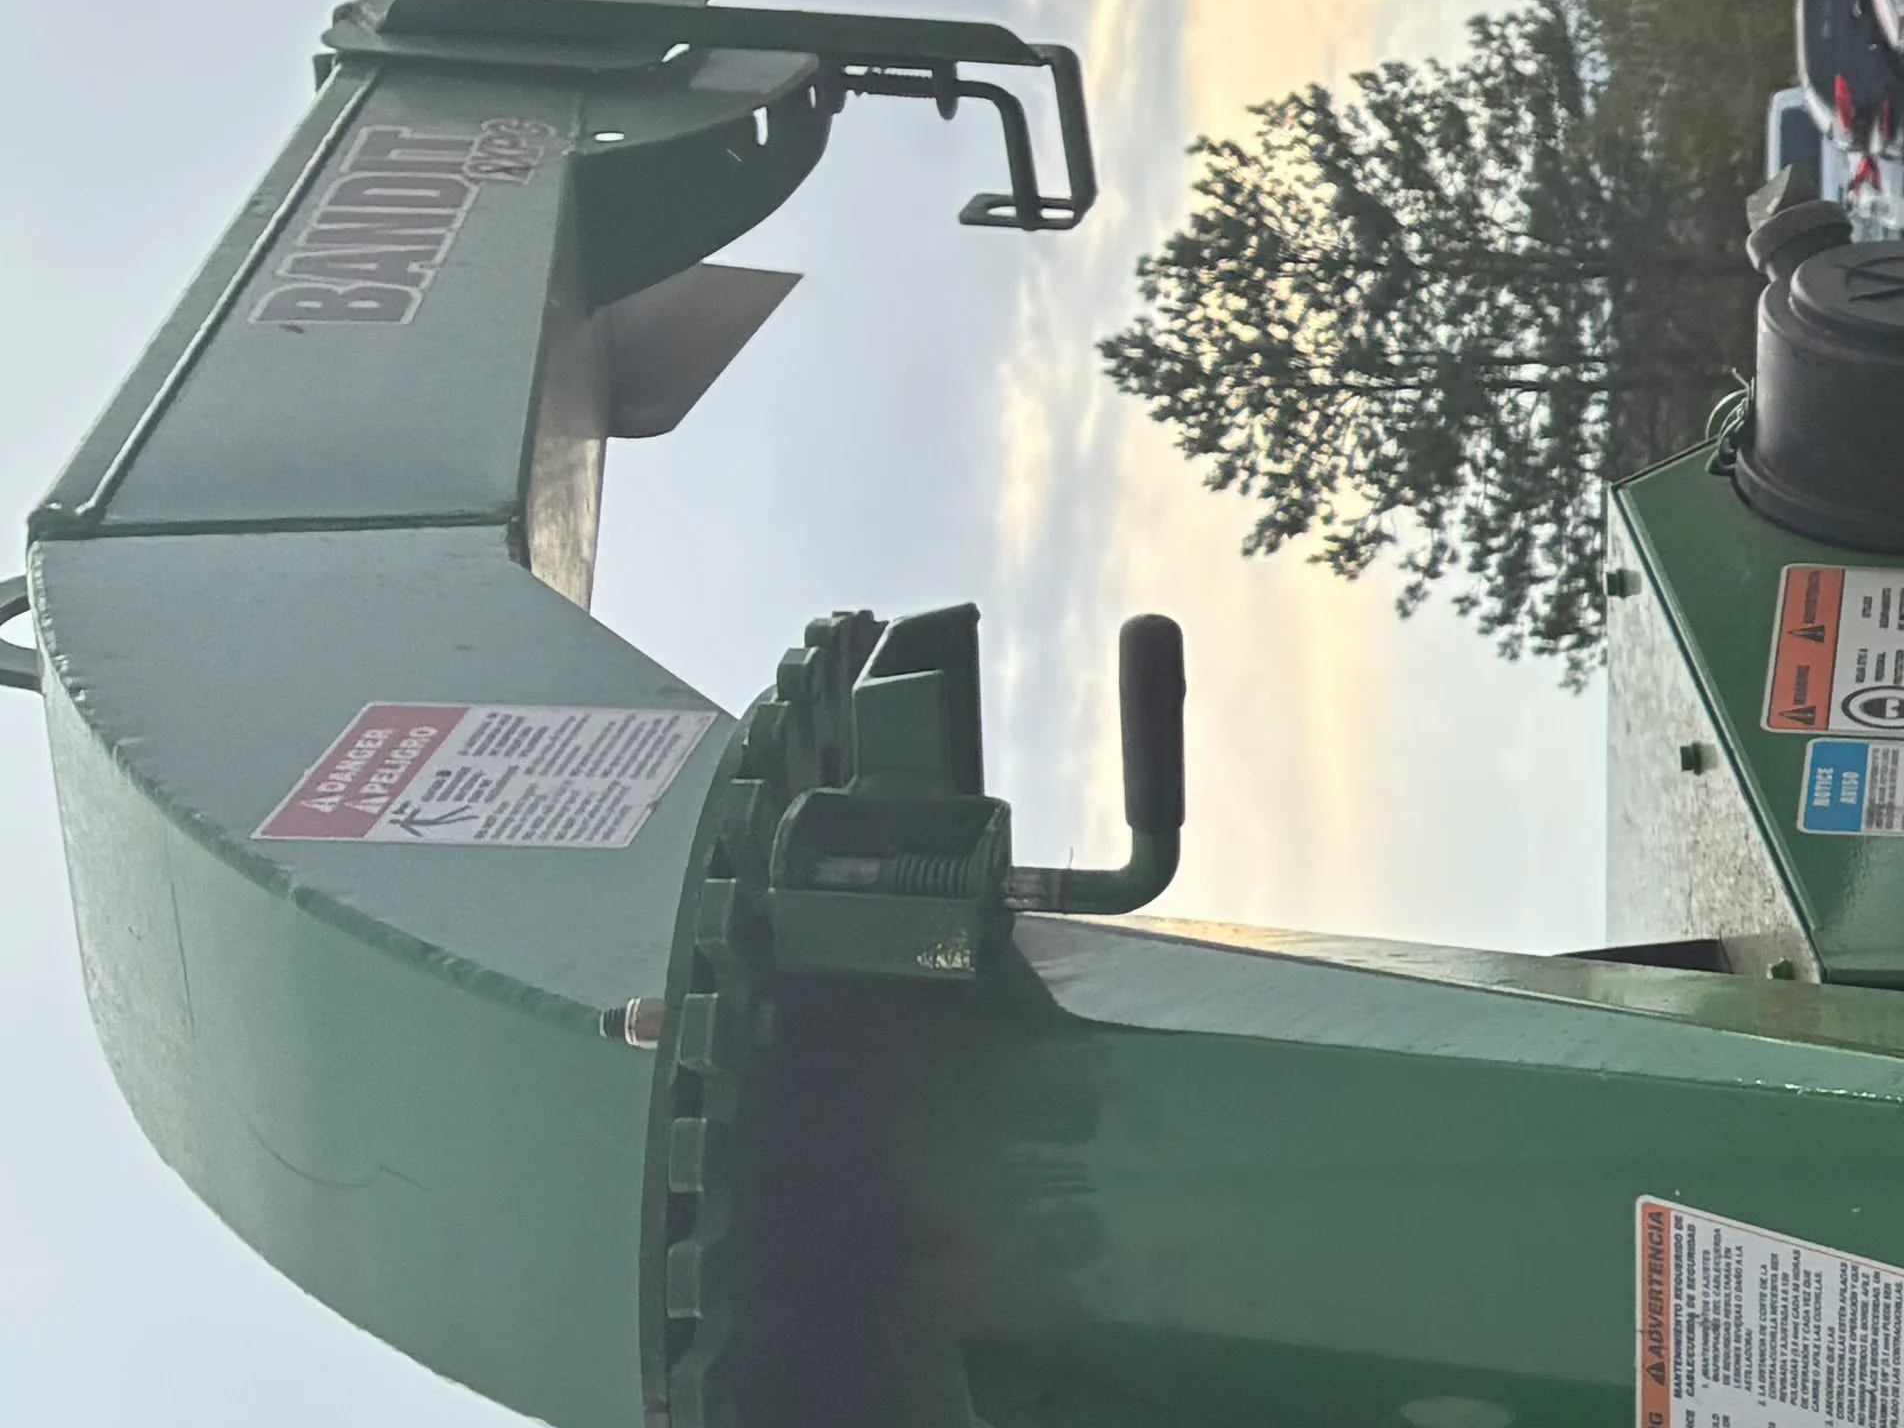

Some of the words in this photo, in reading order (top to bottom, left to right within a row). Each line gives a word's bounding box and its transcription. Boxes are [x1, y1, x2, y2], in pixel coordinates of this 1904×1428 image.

[248, 125, 480, 324] BANDIT
[316, 729, 393, 794] DANGER
[359, 726, 439, 795] PELIGRO
[1812, 767, 1834, 806] NOTICE
[1840, 771, 1859, 804] AVISO
[1674, 1215, 1682, 1231] DE
[1648, 1208, 1663, 1360] ADVERTENCIA
[1674, 1233, 1682, 1301] REQUERIDO
[1687, 1223, 1695, 1291] SEGURIDAD
[1686, 1294, 1694, 1309] DE
